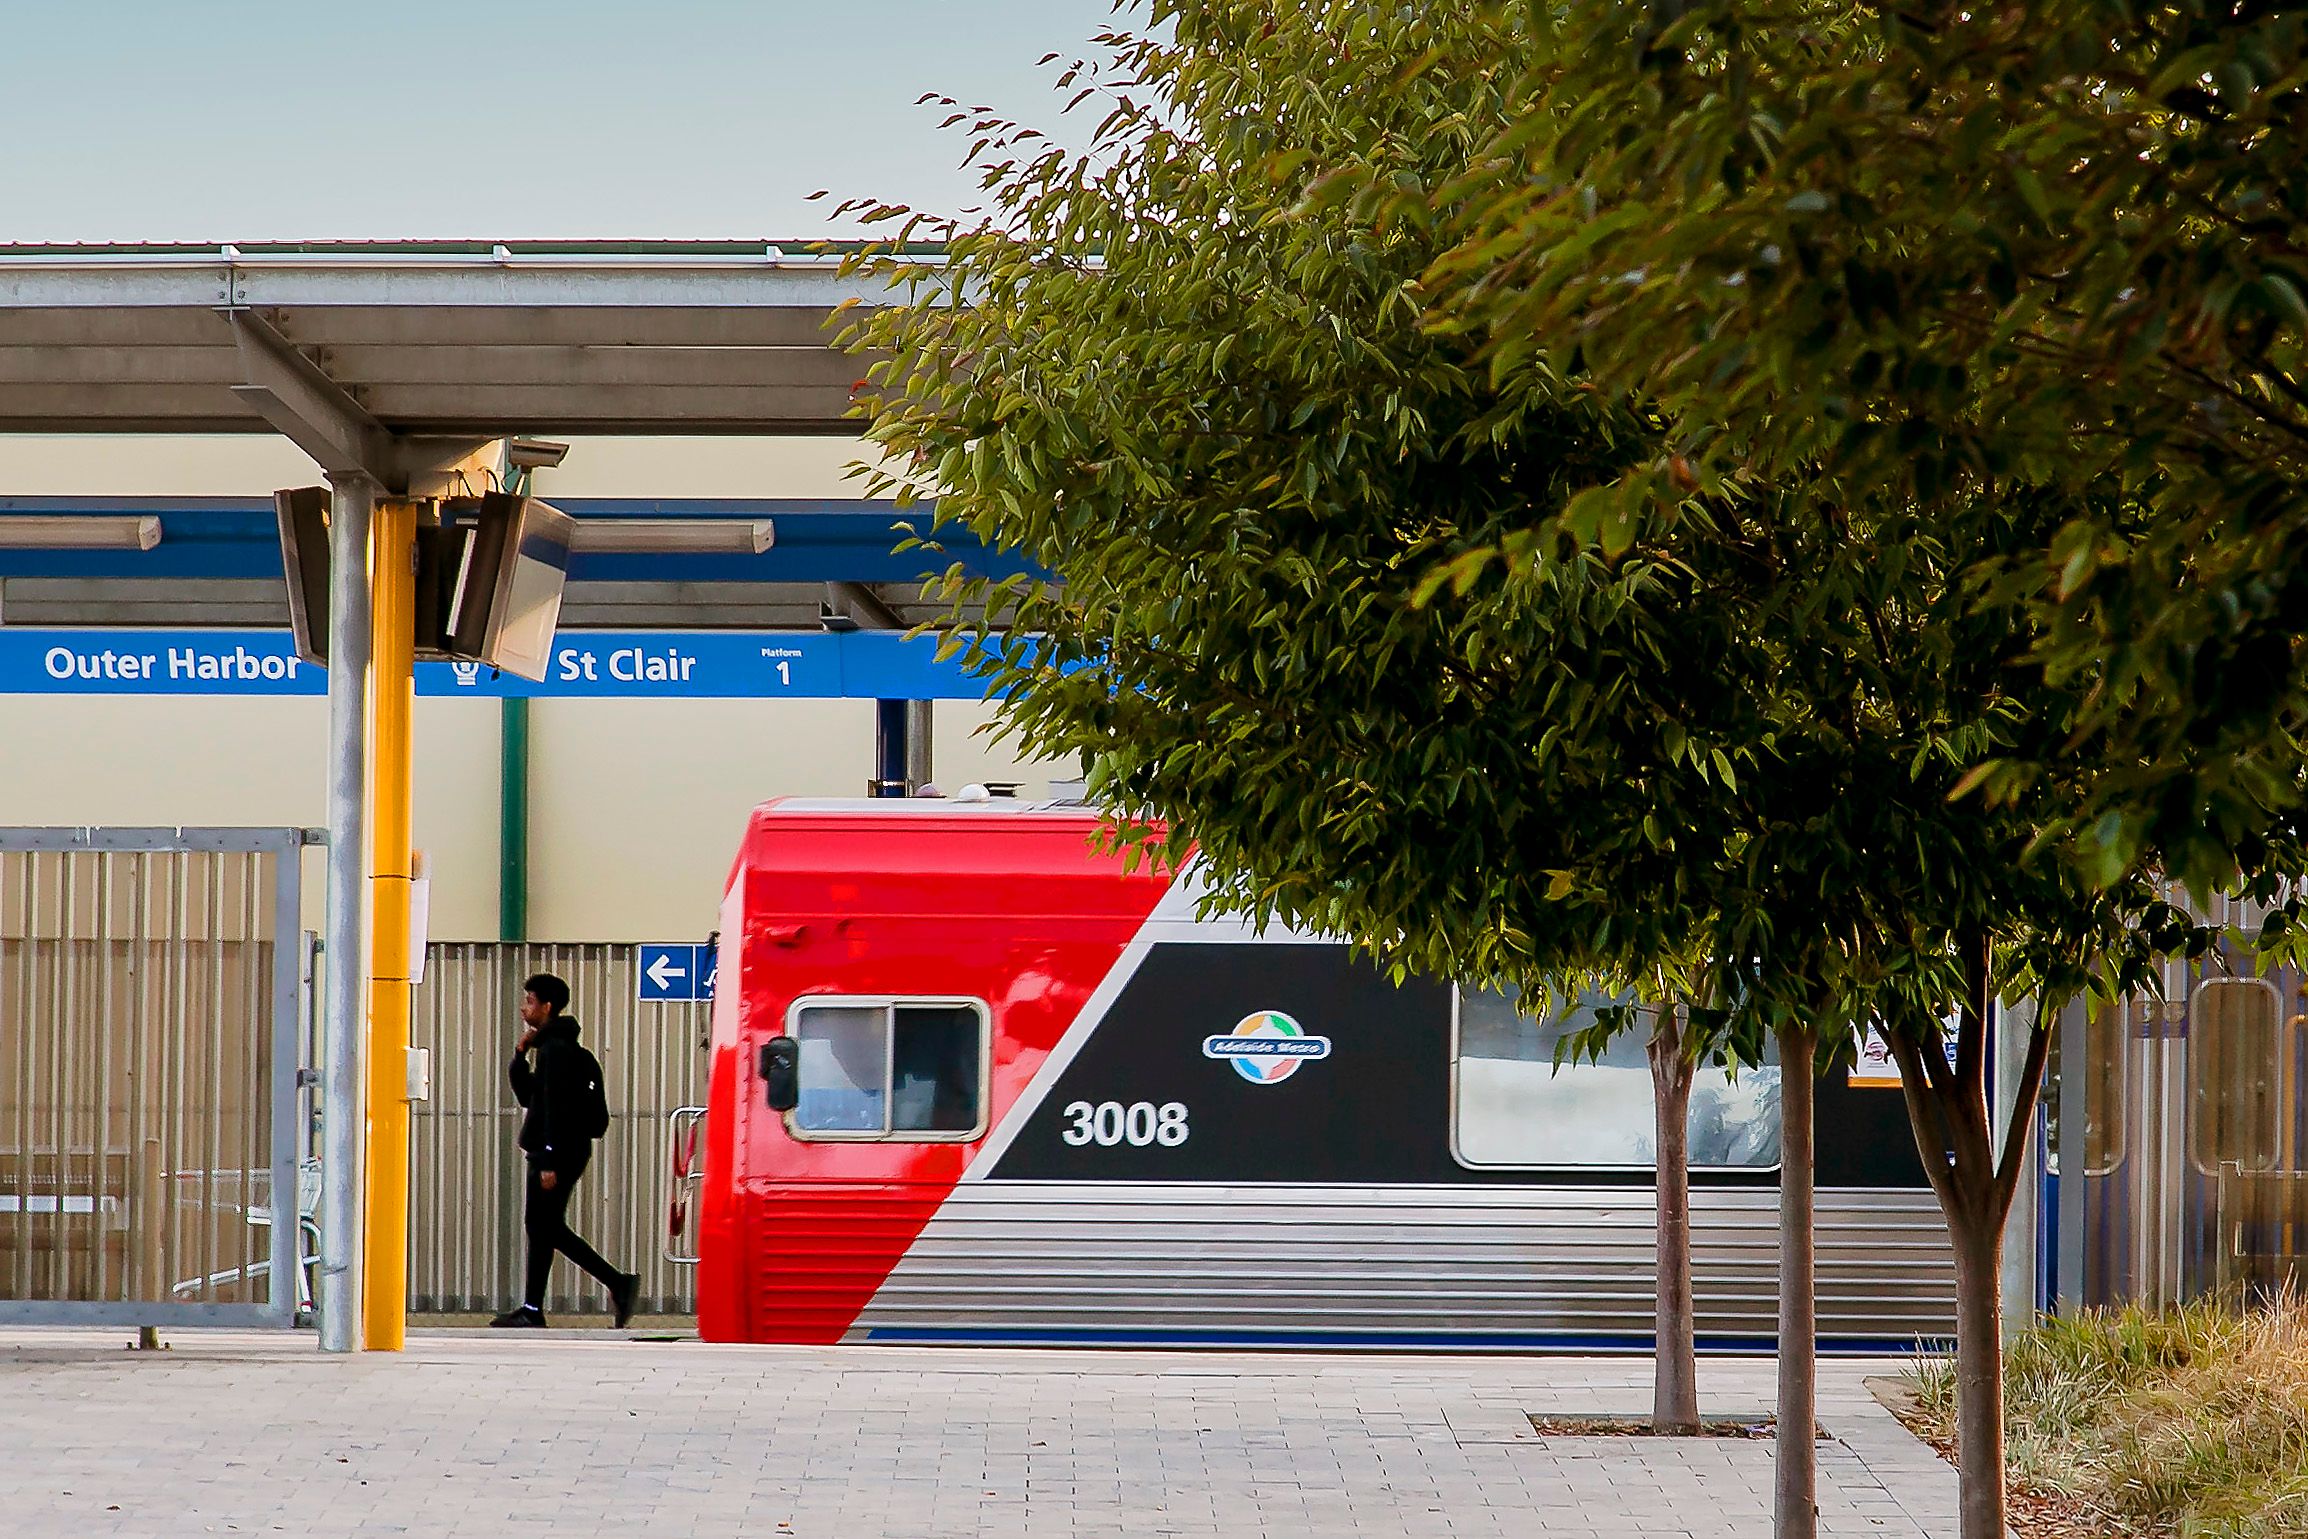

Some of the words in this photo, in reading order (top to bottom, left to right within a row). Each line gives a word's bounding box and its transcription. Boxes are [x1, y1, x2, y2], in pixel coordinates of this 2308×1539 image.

[44, 646, 156, 680] Outer
[168, 646, 301, 681] Harbor
[558, 648, 598, 681] St
[608, 647, 697, 682] Clair
[761, 648, 803, 658] Platform
[775, 661, 791, 686] 1
[1062, 1100, 1190, 1147] 3008
